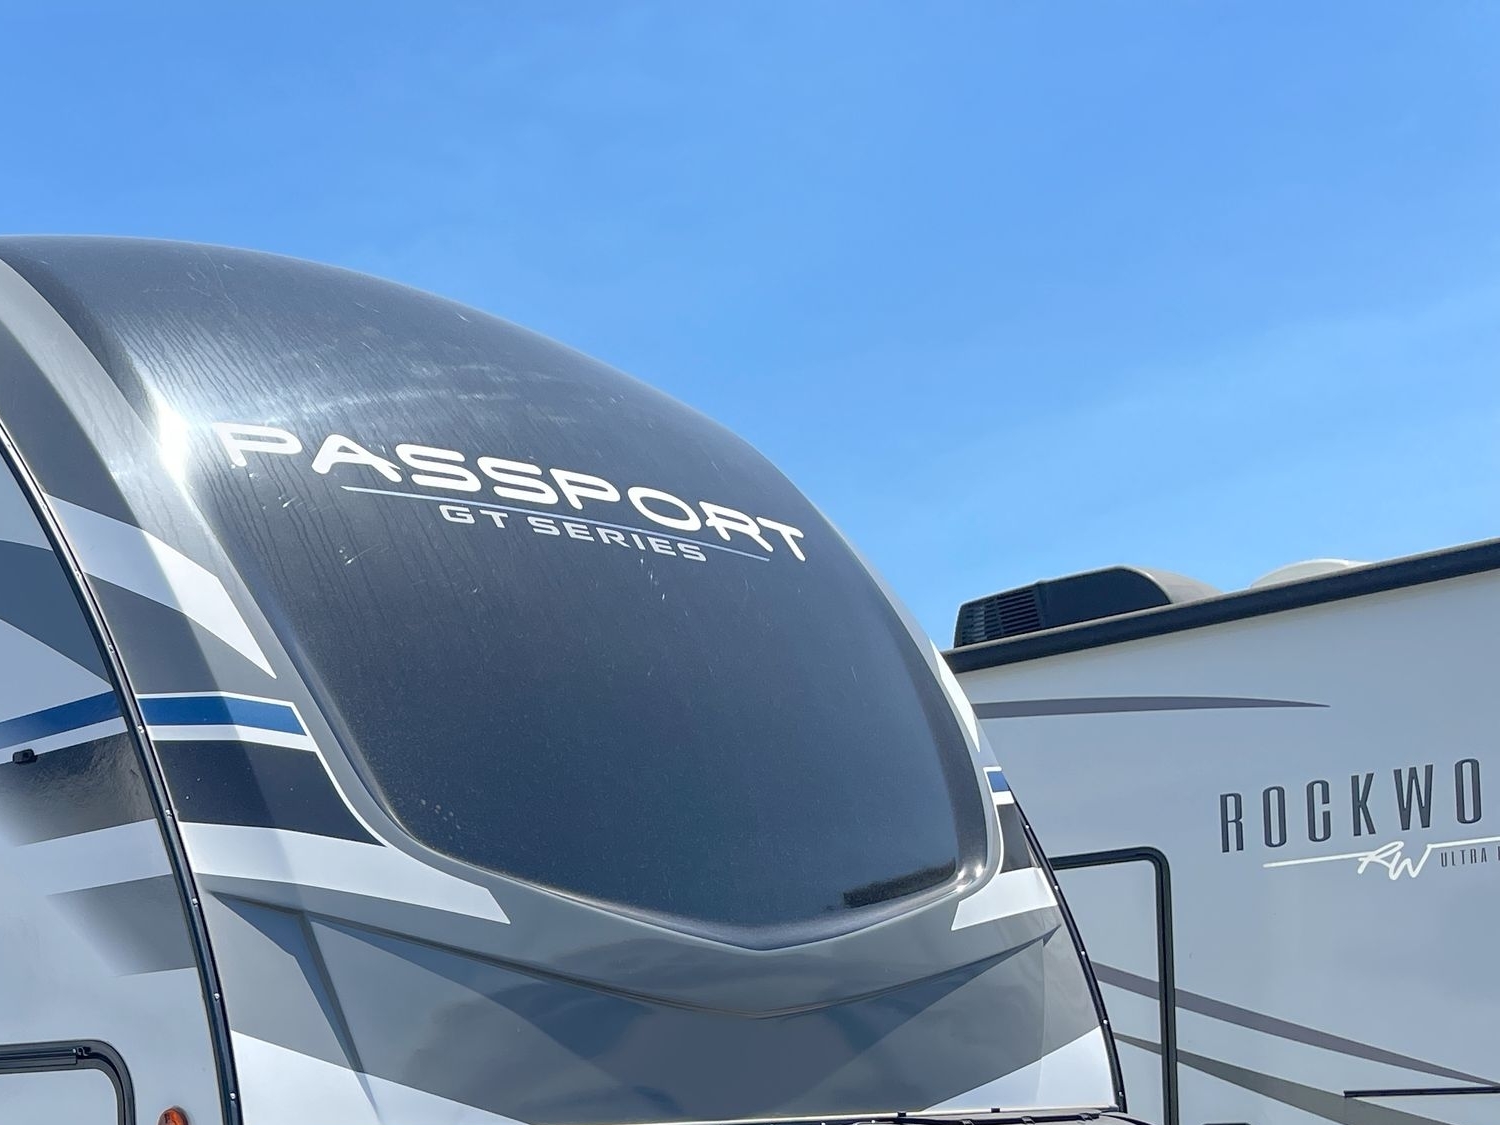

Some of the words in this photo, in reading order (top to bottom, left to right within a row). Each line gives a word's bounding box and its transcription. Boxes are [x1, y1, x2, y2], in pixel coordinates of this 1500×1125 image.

[211, 421, 805, 563] PASSPORT
[439, 503, 509, 530] GT
[526, 514, 707, 563] SERIES
[1219, 757, 1483, 854] ROCKWO
[1440, 847, 1488, 868] ULTRA
